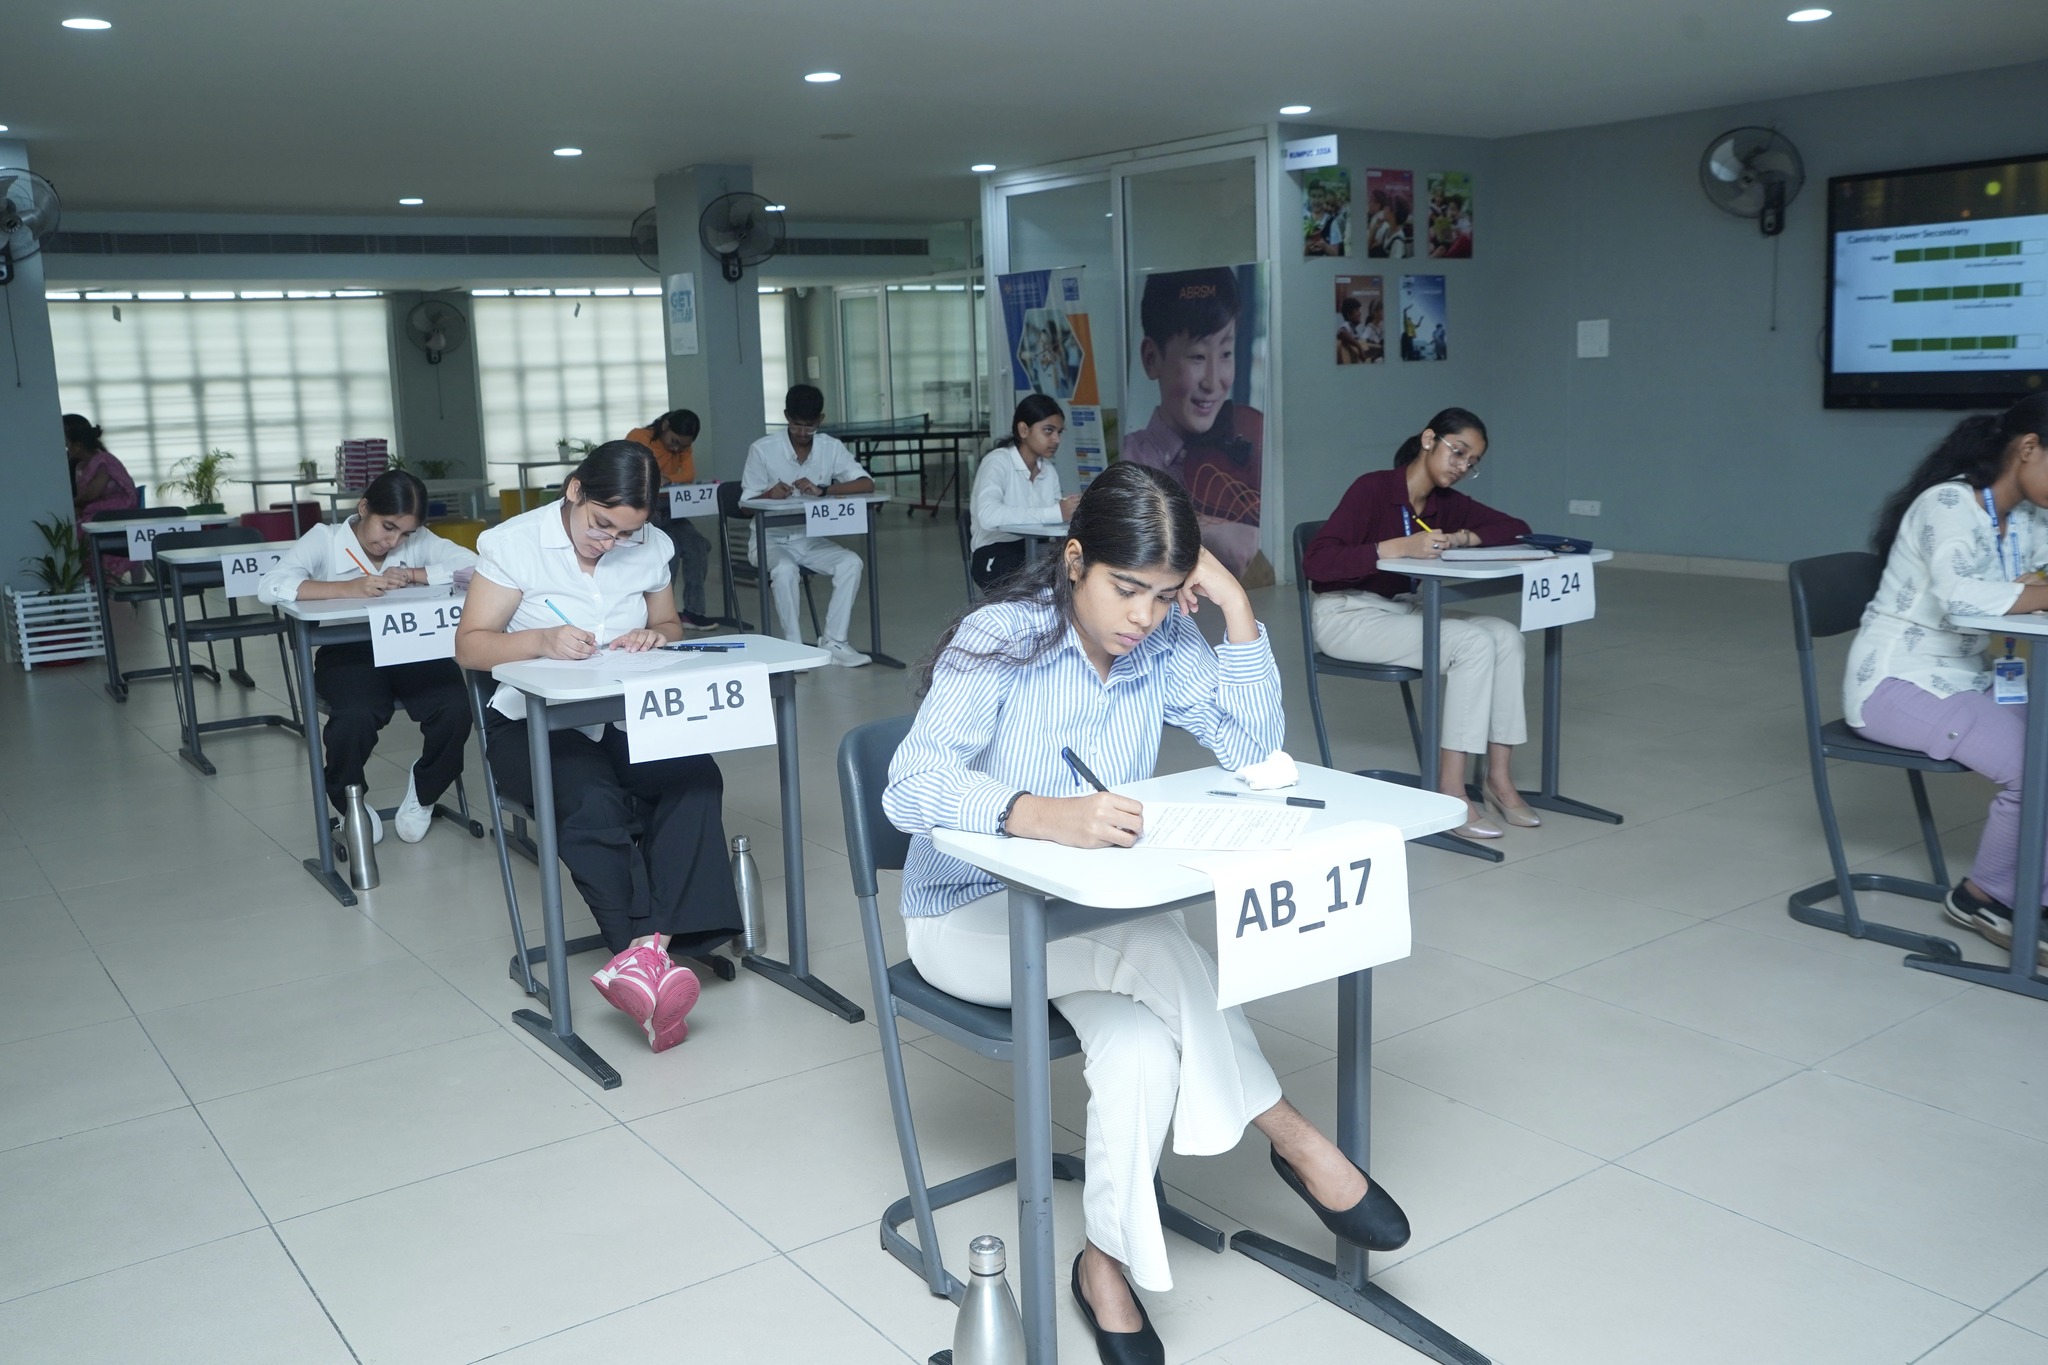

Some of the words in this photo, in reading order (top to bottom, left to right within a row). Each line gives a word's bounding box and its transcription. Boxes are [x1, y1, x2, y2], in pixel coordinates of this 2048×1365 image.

[1895, 231, 1920, 240] Lower
[1923, 227, 1969, 238] Secondary
[670, 290, 692, 309] GET
[1179, 284, 1216, 299] ABRSM
[674, 488, 713, 504] AB_27
[811, 502, 855, 521] AB_26
[231, 555, 281, 576] AB_2
[1528, 572, 1580, 602] AB_24
[381, 605, 463, 637] AB_19
[639, 679, 745, 722] AB_18
[1235, 857, 1372, 939] AB_17
